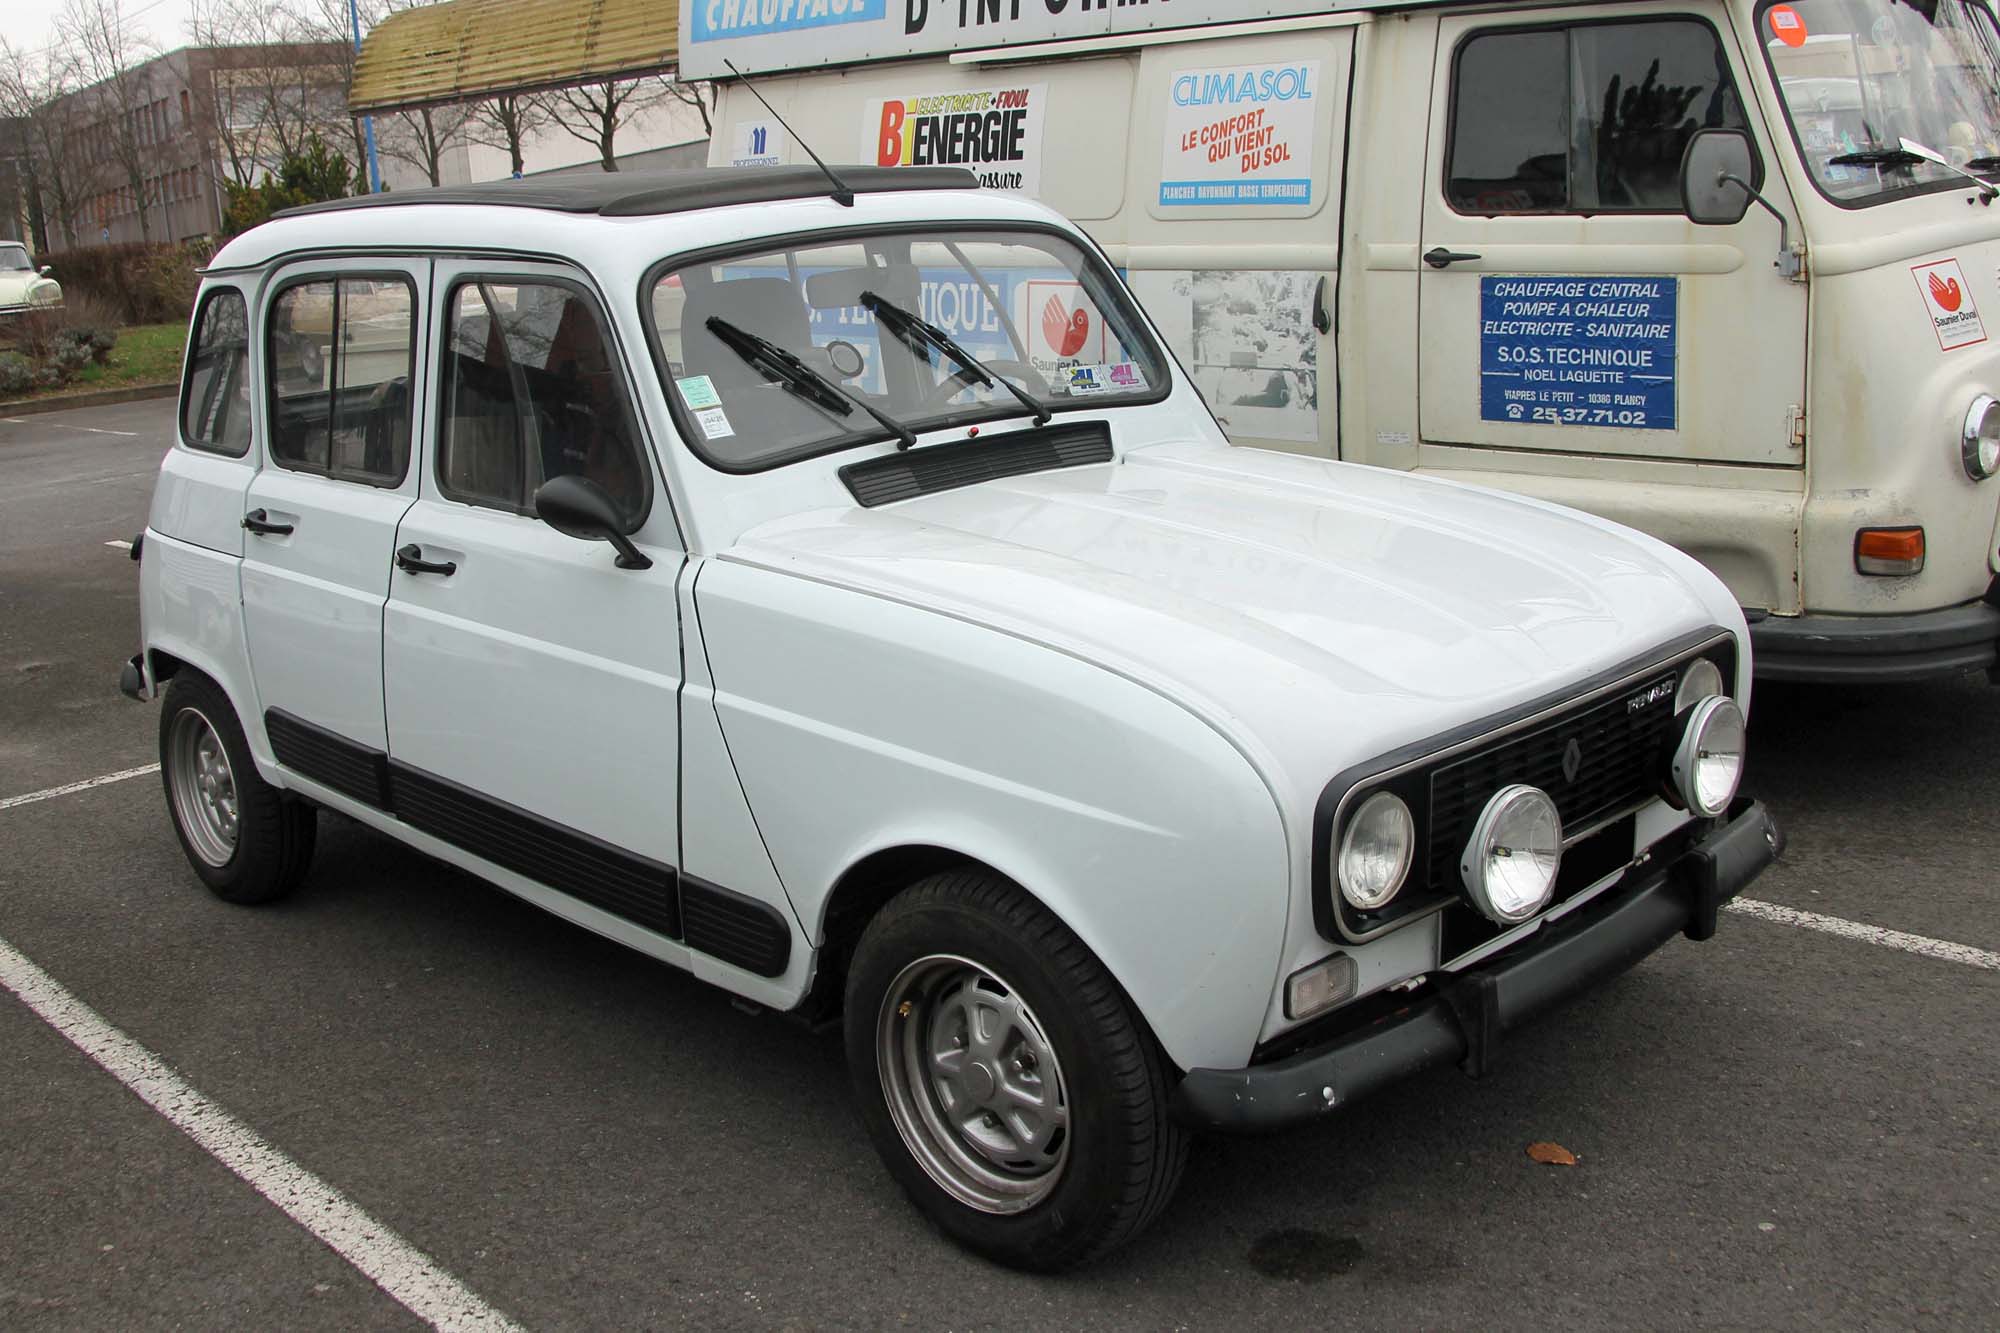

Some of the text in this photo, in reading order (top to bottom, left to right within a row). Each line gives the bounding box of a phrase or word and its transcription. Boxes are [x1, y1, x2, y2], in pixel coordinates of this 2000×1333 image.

[1173, 67, 1311, 106] CLIMASOL
[917, 92, 992, 115] ELECTRICITE
[996, 88, 1029, 109] FIOUL
[1182, 108, 1265, 152] LE CONFORT
[1208, 125, 1274, 163] QUI VIENT
[1241, 142, 1290, 173] DU SOL
[1163, 186, 1195, 199] PLANCHER
[1238, 185, 1259, 198] BASSE
[1261, 184, 1306, 198] TEMPERATURE
[1494, 283, 1660, 298] CHAUFFAGE CENTRAL
[1503, 302, 1650, 318] POMPE A CHALEUR
[1483, 321, 1574, 336] ELECTRICITE
[1585, 323, 1671, 338] SANITAIRE
[1546, 348, 1653, 367] TECHNIQUE
[1524, 369, 1624, 384] NOEL LAGUETTE
[1505, 390, 1536, 401] VIAPRES
[1539, 391, 1549, 401] LE
[1552, 392, 1574, 402] PETIT
[1614, 395, 1646, 406] PLANCY
[1532, 407, 1646, 425] 25.37.71.02
